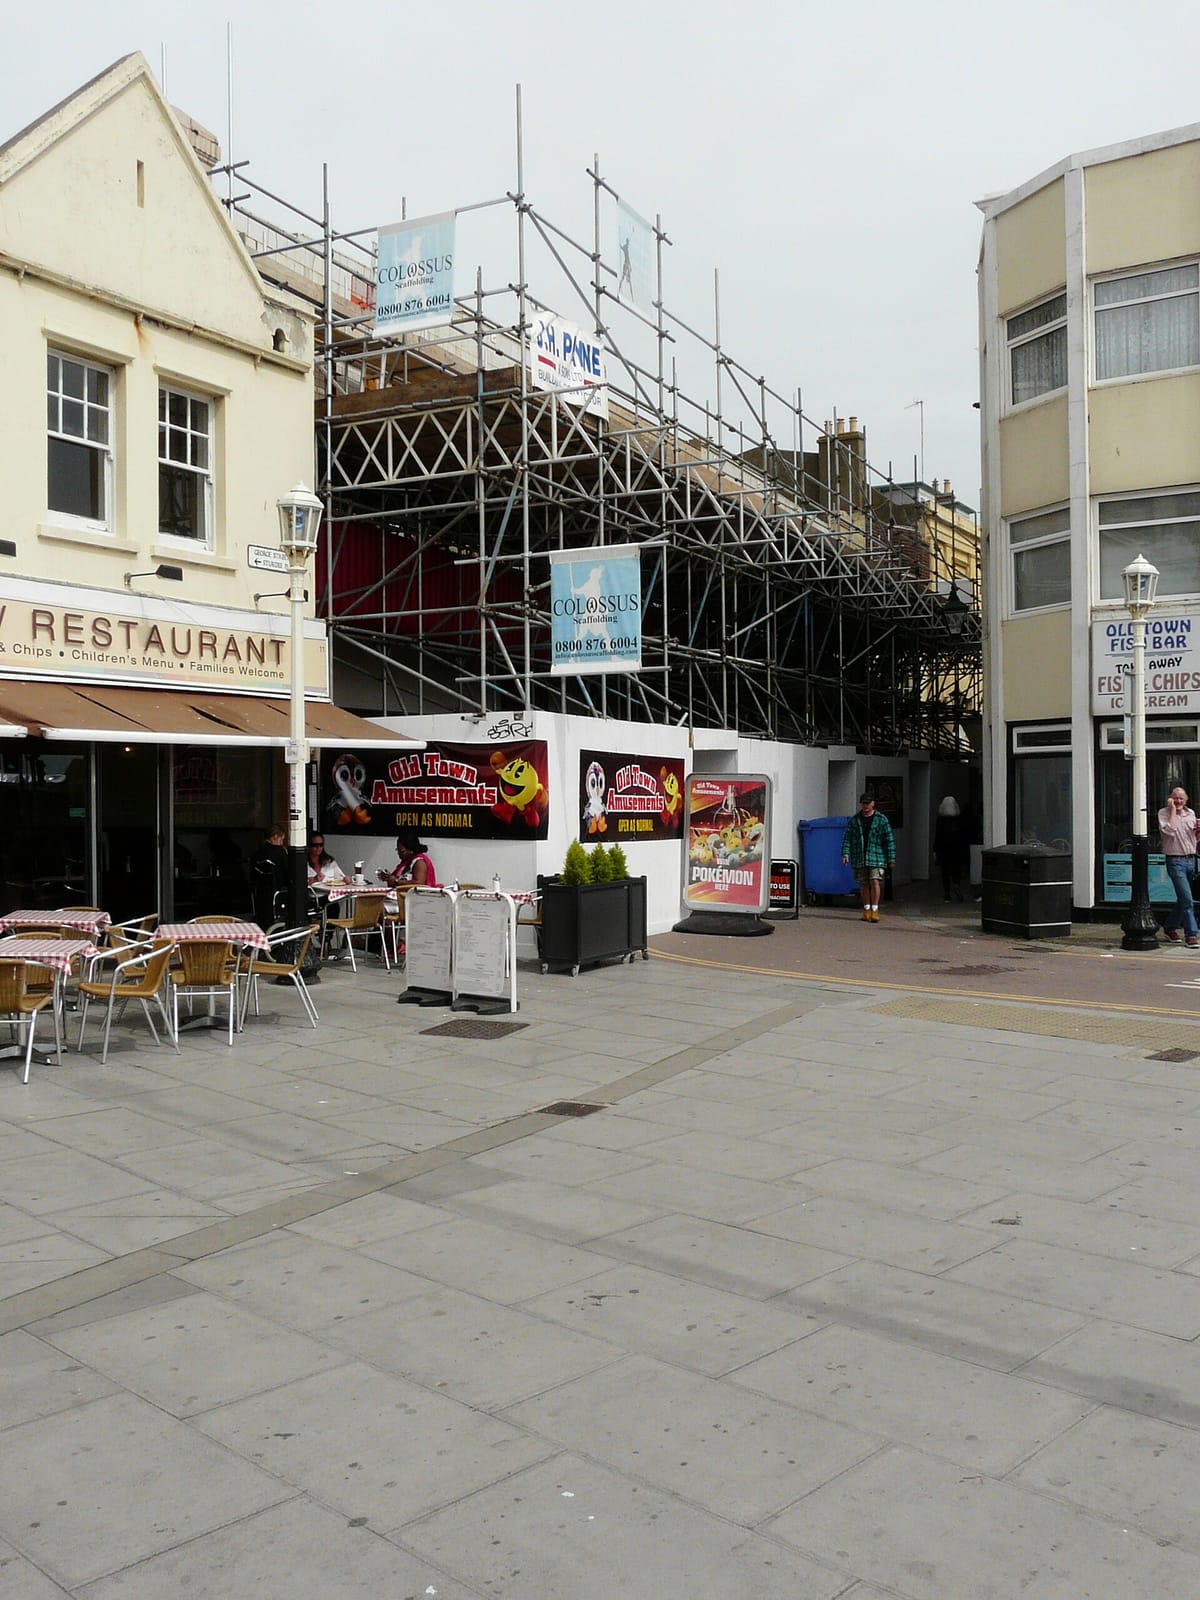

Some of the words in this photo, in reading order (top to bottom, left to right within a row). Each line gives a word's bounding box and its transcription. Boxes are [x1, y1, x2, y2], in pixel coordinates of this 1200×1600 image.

[378, 254, 453, 285] COLOSSUS
[395, 277, 434, 289] Scaffolding
[378, 302, 402, 317] 0800
[404, 299, 423, 312] 876
[426, 293, 450, 307] 6004
[553, 594, 639, 616] COLOSSUS
[573, 614, 618, 624] Scaffolding
[32, 609, 286, 666] RESTAURANT
[555, 639, 582, 653] 0800
[586, 638, 606, 650] 876
[610, 636, 638, 649] 6004
[1152, 635, 1187, 649] BAR
[13, 643, 52, 658] Chips
[72, 649, 137, 665] Children's
[142, 656, 174, 668] Menu
[190, 661, 235, 674] Families
[238, 666, 285, 679] Welcome
[1149, 656, 1182, 670] AWAY
[1098, 675, 1122, 693] FIS
[1152, 671, 1200, 691] CHIPS
[1144, 694, 1188, 708] REAM
[388, 754, 422, 784] Old
[424, 752, 477, 786] Town
[616, 765, 631, 793] Old
[631, 765, 657, 795] Town
[371, 780, 497, 806] Amusements
[607, 788, 664, 812] Amusements
[396, 812, 418, 826] OPEN
[421, 812, 433, 826] AS
[435, 812, 473, 828] NORMAL
[692, 866, 753, 886] POKÉMON
